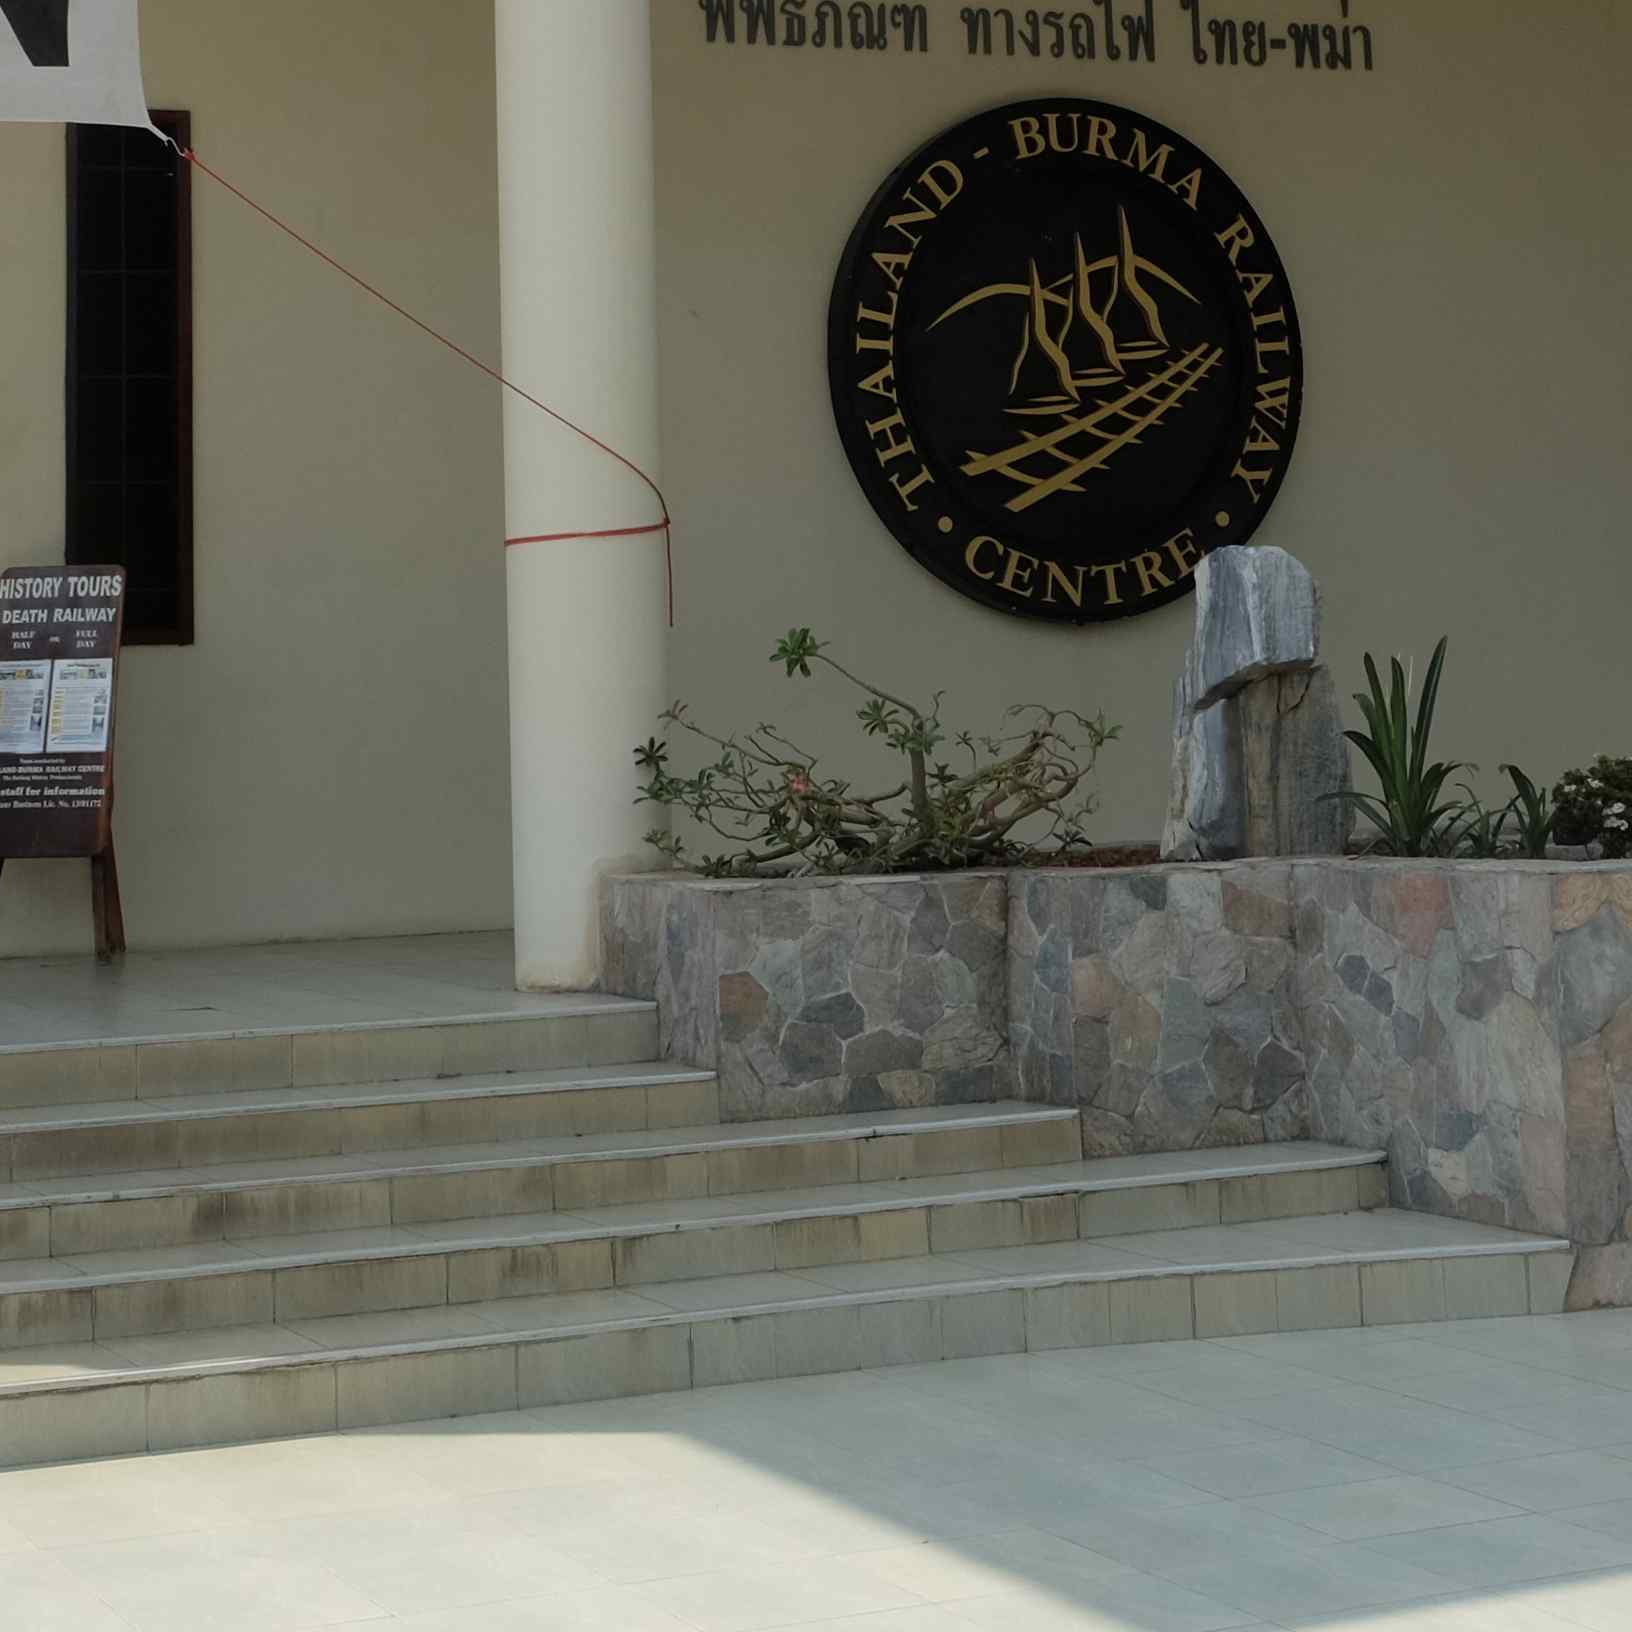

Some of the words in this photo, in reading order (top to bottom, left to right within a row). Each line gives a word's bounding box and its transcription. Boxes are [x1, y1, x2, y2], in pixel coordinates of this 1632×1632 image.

[856, 159, 964, 511] THAILAND
[1008, 113, 1204, 210] BURMA
[1214, 214, 1291, 503] RAILWAY
[965, 527, 1205, 607] CENTRE
[67, 575, 122, 597] TOURS
[2, 609, 47, 624] DEATH
[52, 607, 116, 623] RAILWAY
[26, 786, 41, 797] for
[43, 785, 106, 797] information
